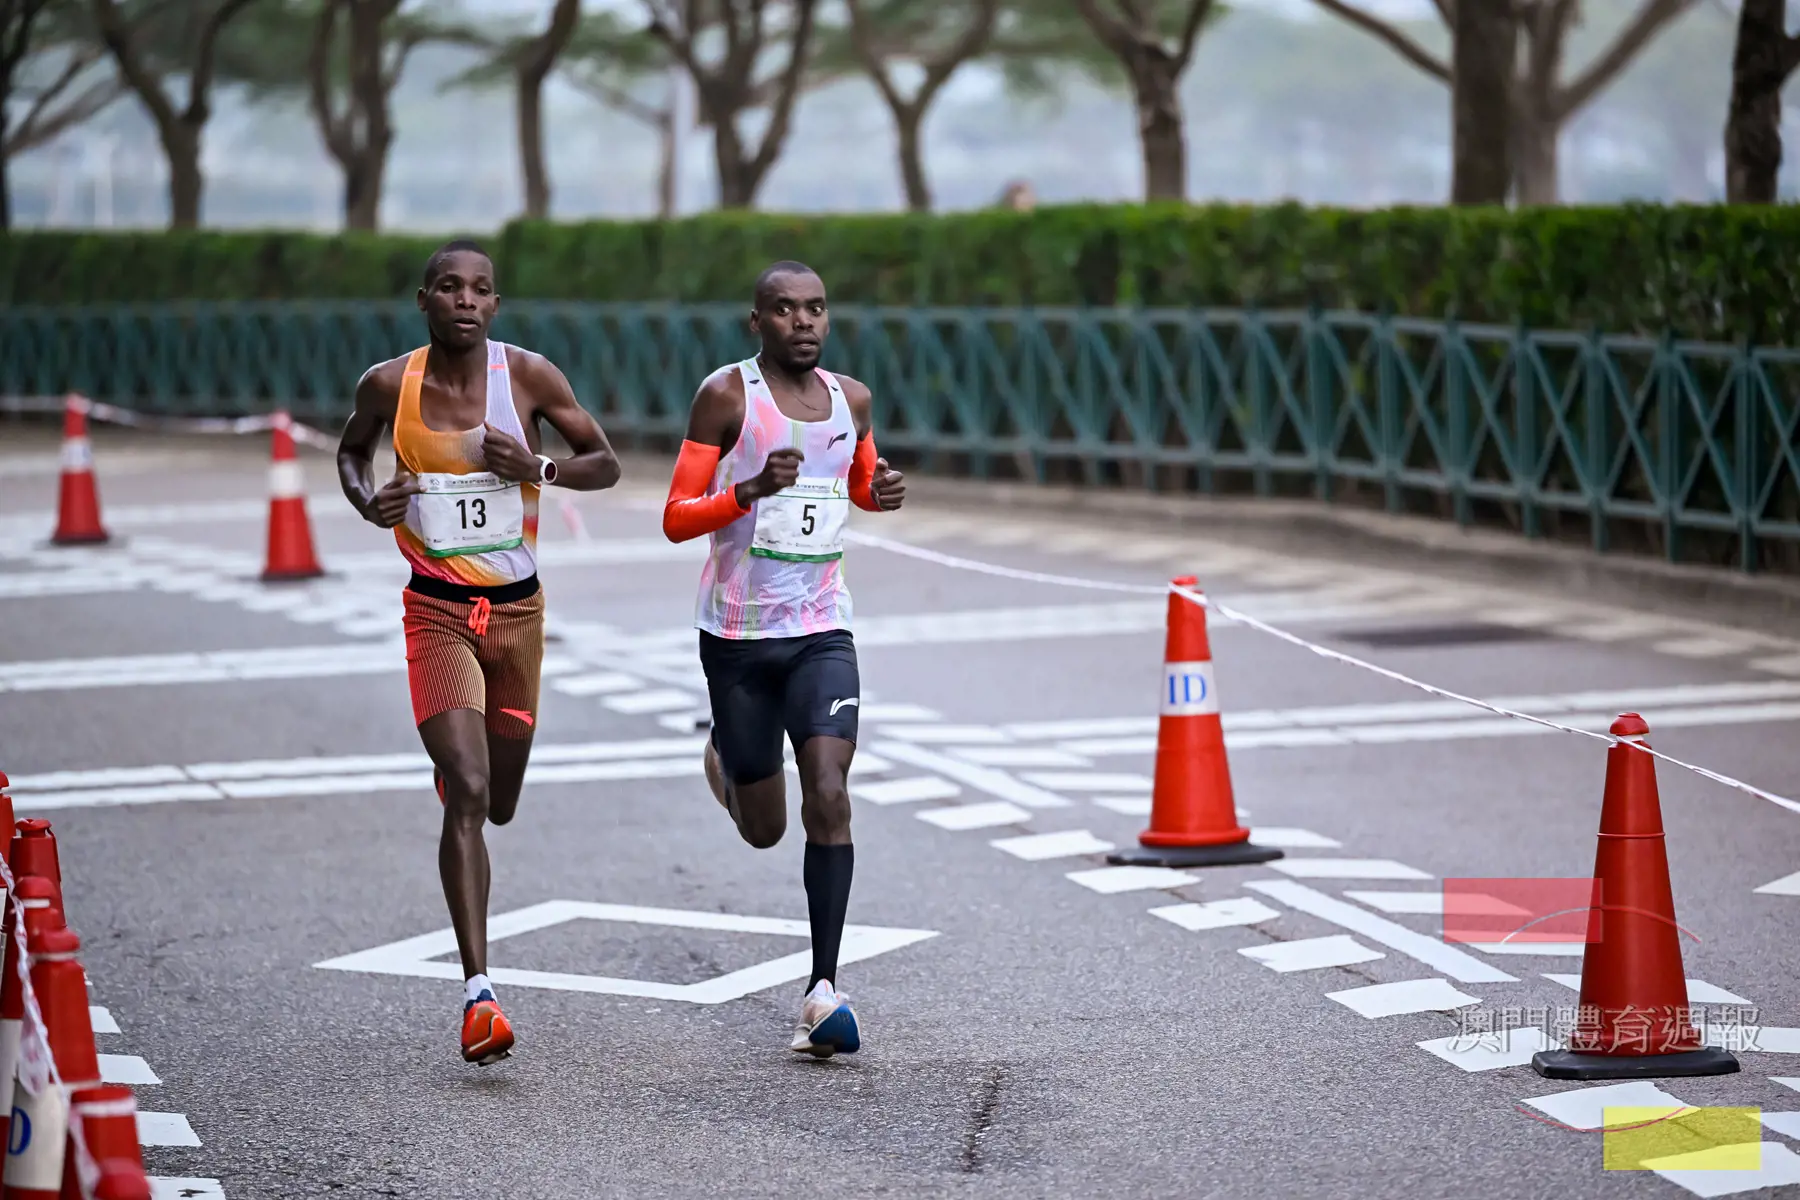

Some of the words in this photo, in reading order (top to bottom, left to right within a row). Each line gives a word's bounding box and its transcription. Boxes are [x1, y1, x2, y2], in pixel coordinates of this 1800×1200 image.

[456, 498, 487, 530] 13
[801, 504, 817, 536] 5
[1168, 673, 1207, 705] ID
